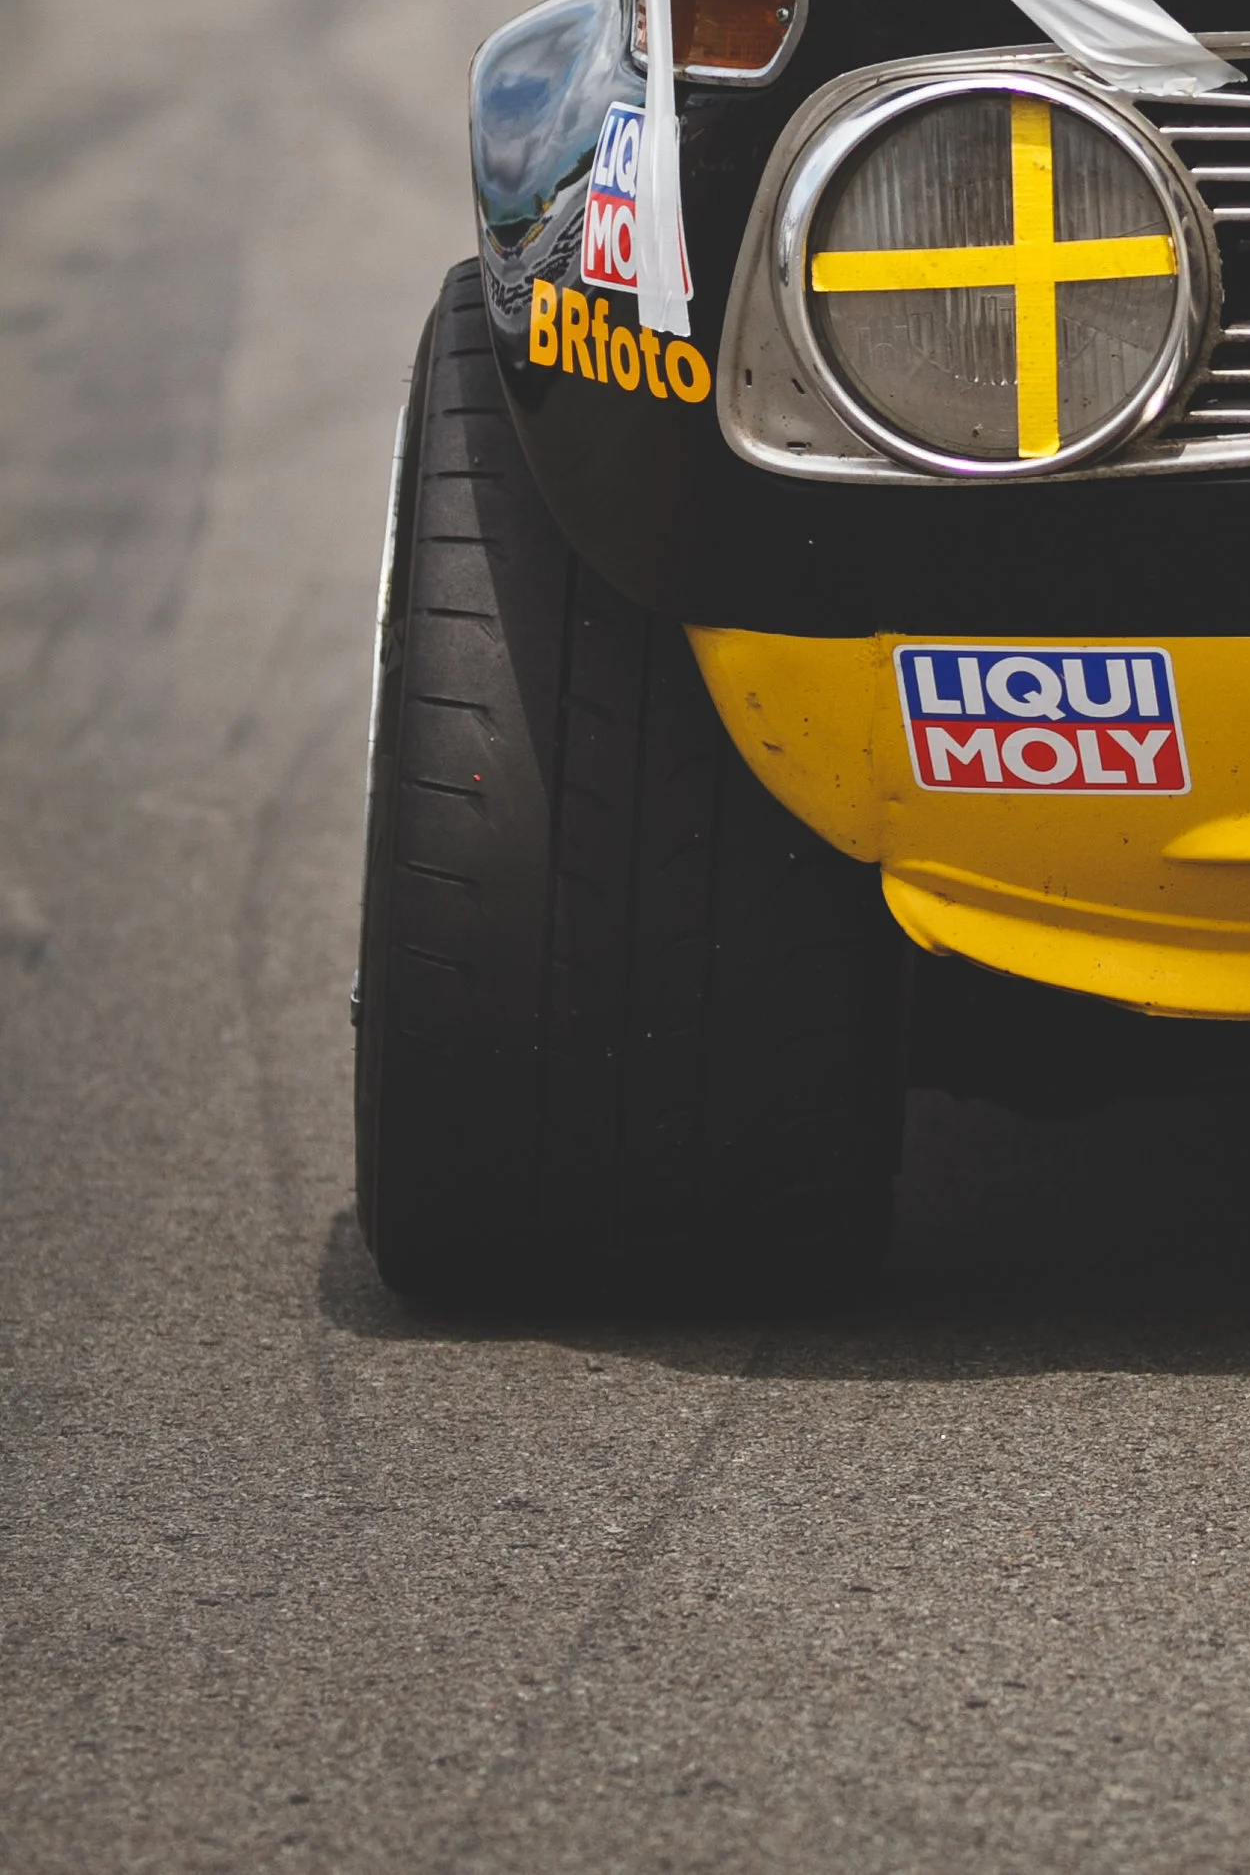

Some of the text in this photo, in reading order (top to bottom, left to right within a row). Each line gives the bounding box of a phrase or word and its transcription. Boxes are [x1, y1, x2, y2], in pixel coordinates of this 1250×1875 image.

[594, 114, 644, 198] LIQ
[586, 200, 638, 281] MO
[529, 277, 712, 403] BRfoto
[912, 655, 1161, 722] LIQUI
[924, 726, 1173, 786] MOLY
